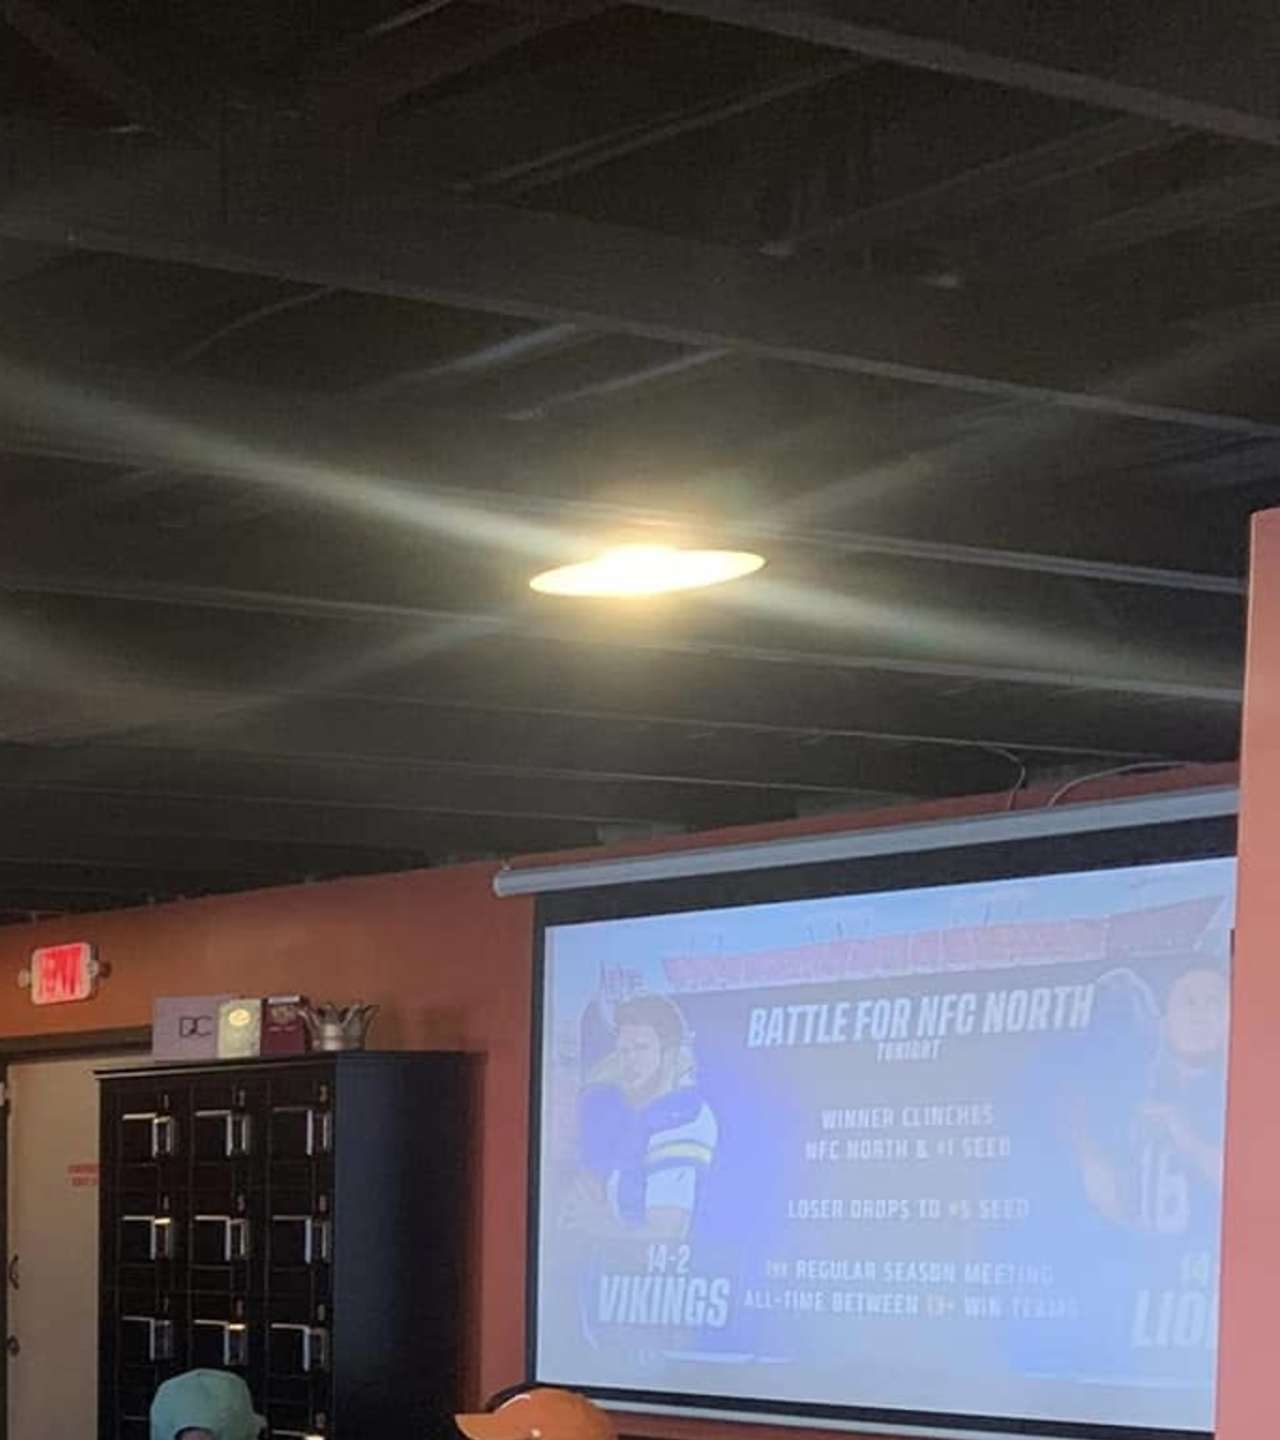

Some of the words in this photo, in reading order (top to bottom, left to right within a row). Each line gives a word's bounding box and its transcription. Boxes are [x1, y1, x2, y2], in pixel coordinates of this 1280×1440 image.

[747, 1001, 850, 1047] BATTLE
[853, 996, 911, 1040] FOR
[916, 992, 977, 1037] NFC
[981, 983, 1095, 1034] NORTH
[876, 1039, 942, 1063] TONIGHT
[822, 1106, 894, 1130] WINNER
[901, 1102, 994, 1128] CLINCHES
[805, 1139, 840, 1161] NFC
[846, 1138, 909, 1160] NORTH
[961, 1135, 1011, 1157] SEED
[787, 1198, 844, 1220] LOSER
[850, 1198, 910, 1220] DROPS
[919, 1198, 941, 1220] TO
[979, 1198, 1031, 1220] SEED
[648, 1243, 691, 1274] 14-2
[796, 1259, 877, 1282] REGULAR
[883, 1261, 956, 1283] SEASON
[964, 1262, 1055, 1286] MEETING
[598, 1275, 731, 1329] VIKINGS
[743, 1288, 824, 1311] ALL-TIME
[831, 1291, 919, 1316] BETWEEN
[964, 1295, 1002, 1318] WIN
[1011, 1296, 1080, 1320] TEAMS
